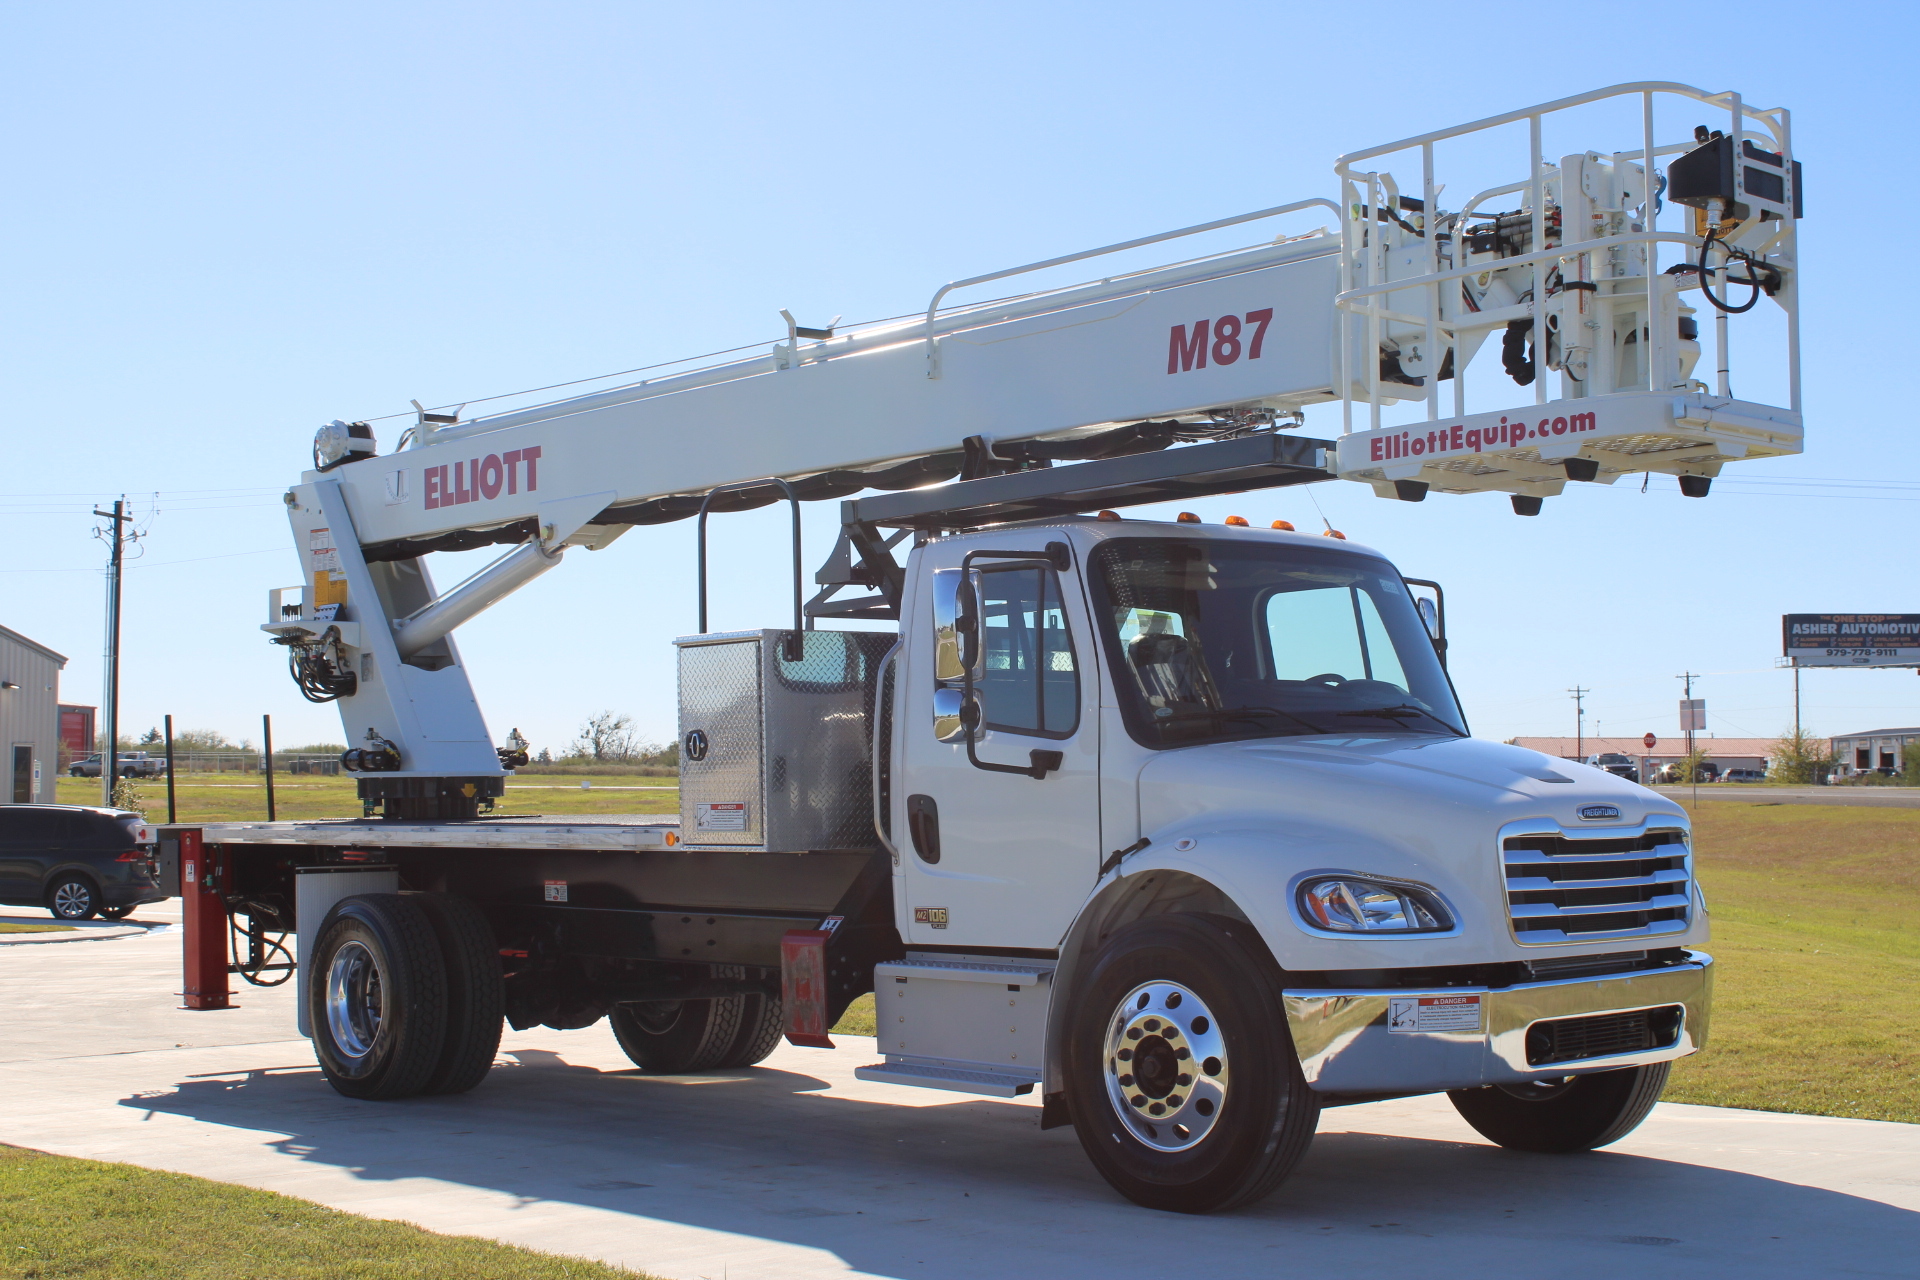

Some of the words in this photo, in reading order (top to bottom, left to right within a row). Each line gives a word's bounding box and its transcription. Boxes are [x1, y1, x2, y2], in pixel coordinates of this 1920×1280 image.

[1168, 307, 1273, 375] M87
[1371, 411, 1595, 462] ElliottEquip.com
[424, 445, 541, 511] ELLIOTT
[1792, 624, 1837, 634] ASHER
[929, 910, 947, 922] 106
